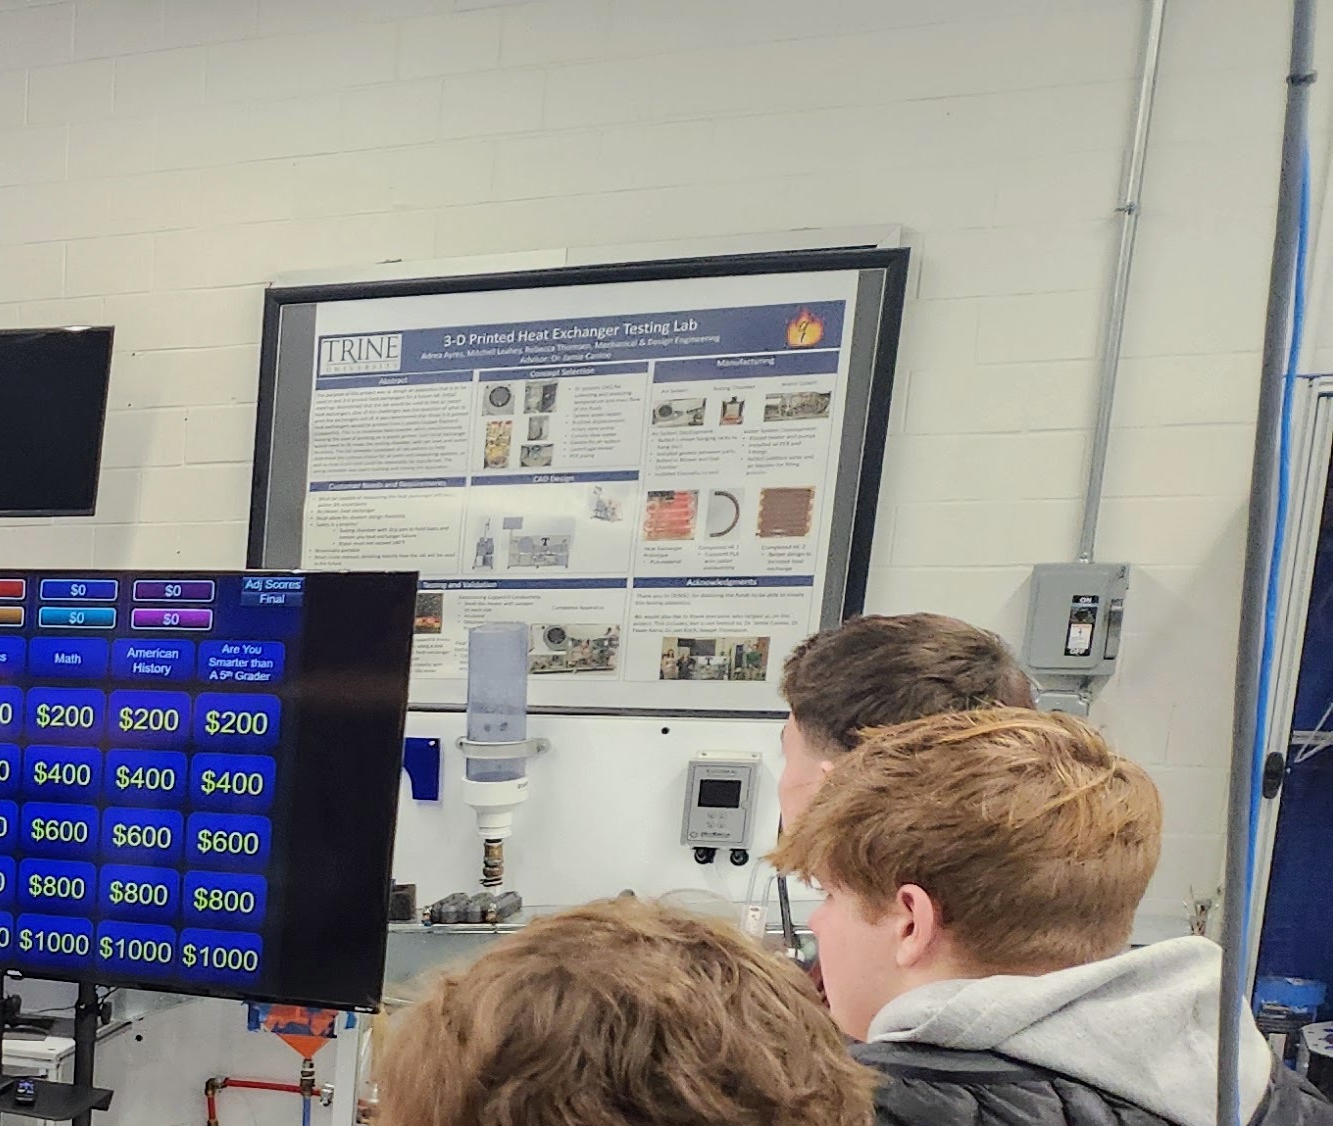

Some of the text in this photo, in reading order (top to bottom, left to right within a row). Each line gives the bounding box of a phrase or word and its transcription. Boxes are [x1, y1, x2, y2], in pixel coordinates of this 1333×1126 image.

[444, 318, 698, 347] 3-D Printed Heat Exchanger Testing Lab
[322, 335, 400, 363] TRINE
[561, 367, 595, 376] Selection
[716, 356, 775, 368] Manufacturing
[378, 376, 408, 385] Abstract
[550, 474, 574, 483] Design
[70, 584, 86, 597] $0
[165, 585, 181, 597] $0
[244, 579, 302, 591] Adj Scores
[259, 593, 285, 604] Final
[68, 611, 85, 624] $0
[163, 613, 180, 626] $0
[54, 652, 82, 665] Math
[127, 648, 179, 660] American
[221, 644, 262, 655] Are You
[133, 662, 172, 676] History
[208, 657, 273, 669] Smarter than
[209, 671, 219, 681] A
[235, 671, 271, 681] Grader
[36, 703, 94, 728] $200
[118, 706, 179, 732] $200
[204, 709, 268, 736] $200
[33, 761, 91, 786] $400
[115, 765, 175, 791] $400
[200, 769, 263, 796] $400
[30, 818, 88, 843] $600
[112, 823, 172, 849] $600
[197, 828, 259, 855] $600
[28, 873, 85, 900] $800
[108, 880, 168, 906] $800
[193, 887, 255, 913] $800
[19, 928, 89, 955] $1000
[99, 936, 172, 963] $1000
[182, 943, 258, 972] $1000
